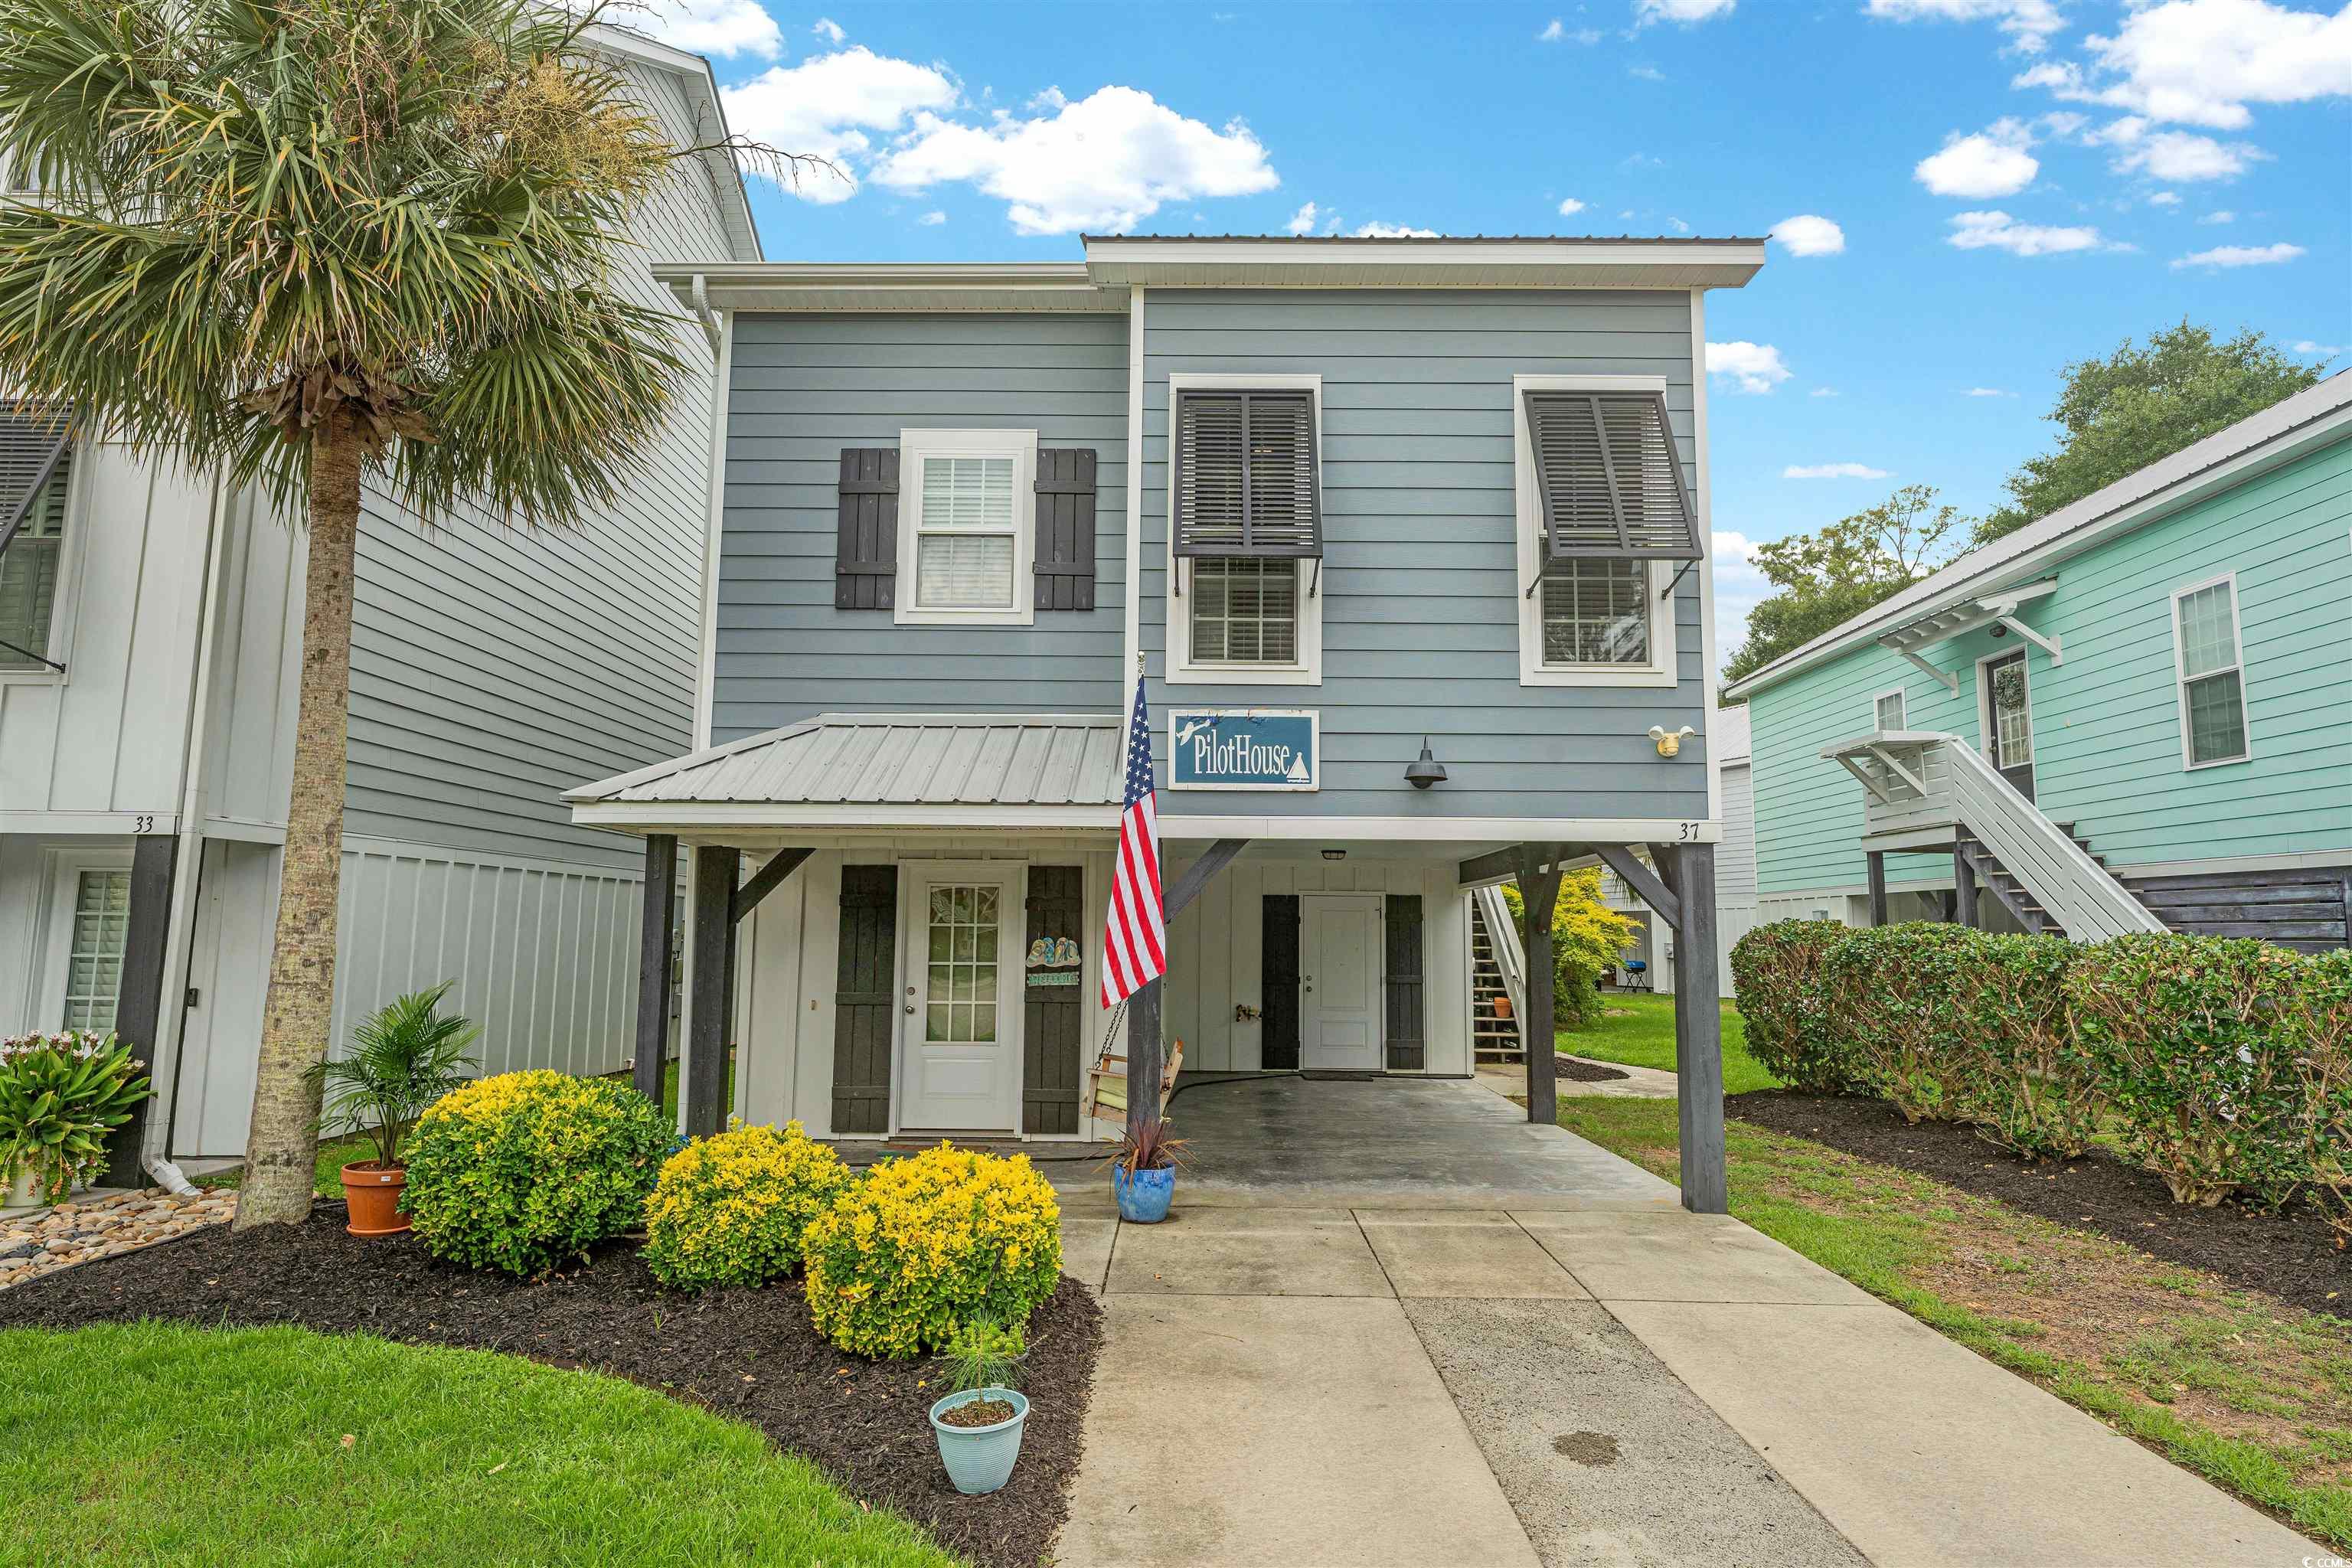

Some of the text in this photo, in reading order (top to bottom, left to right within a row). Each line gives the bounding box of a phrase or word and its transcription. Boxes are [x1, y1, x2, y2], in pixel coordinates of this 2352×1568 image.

[1194, 729, 1291, 775] PilotHouse
[132, 816, 153, 833] 33
[1679, 822, 1699, 841] 37
